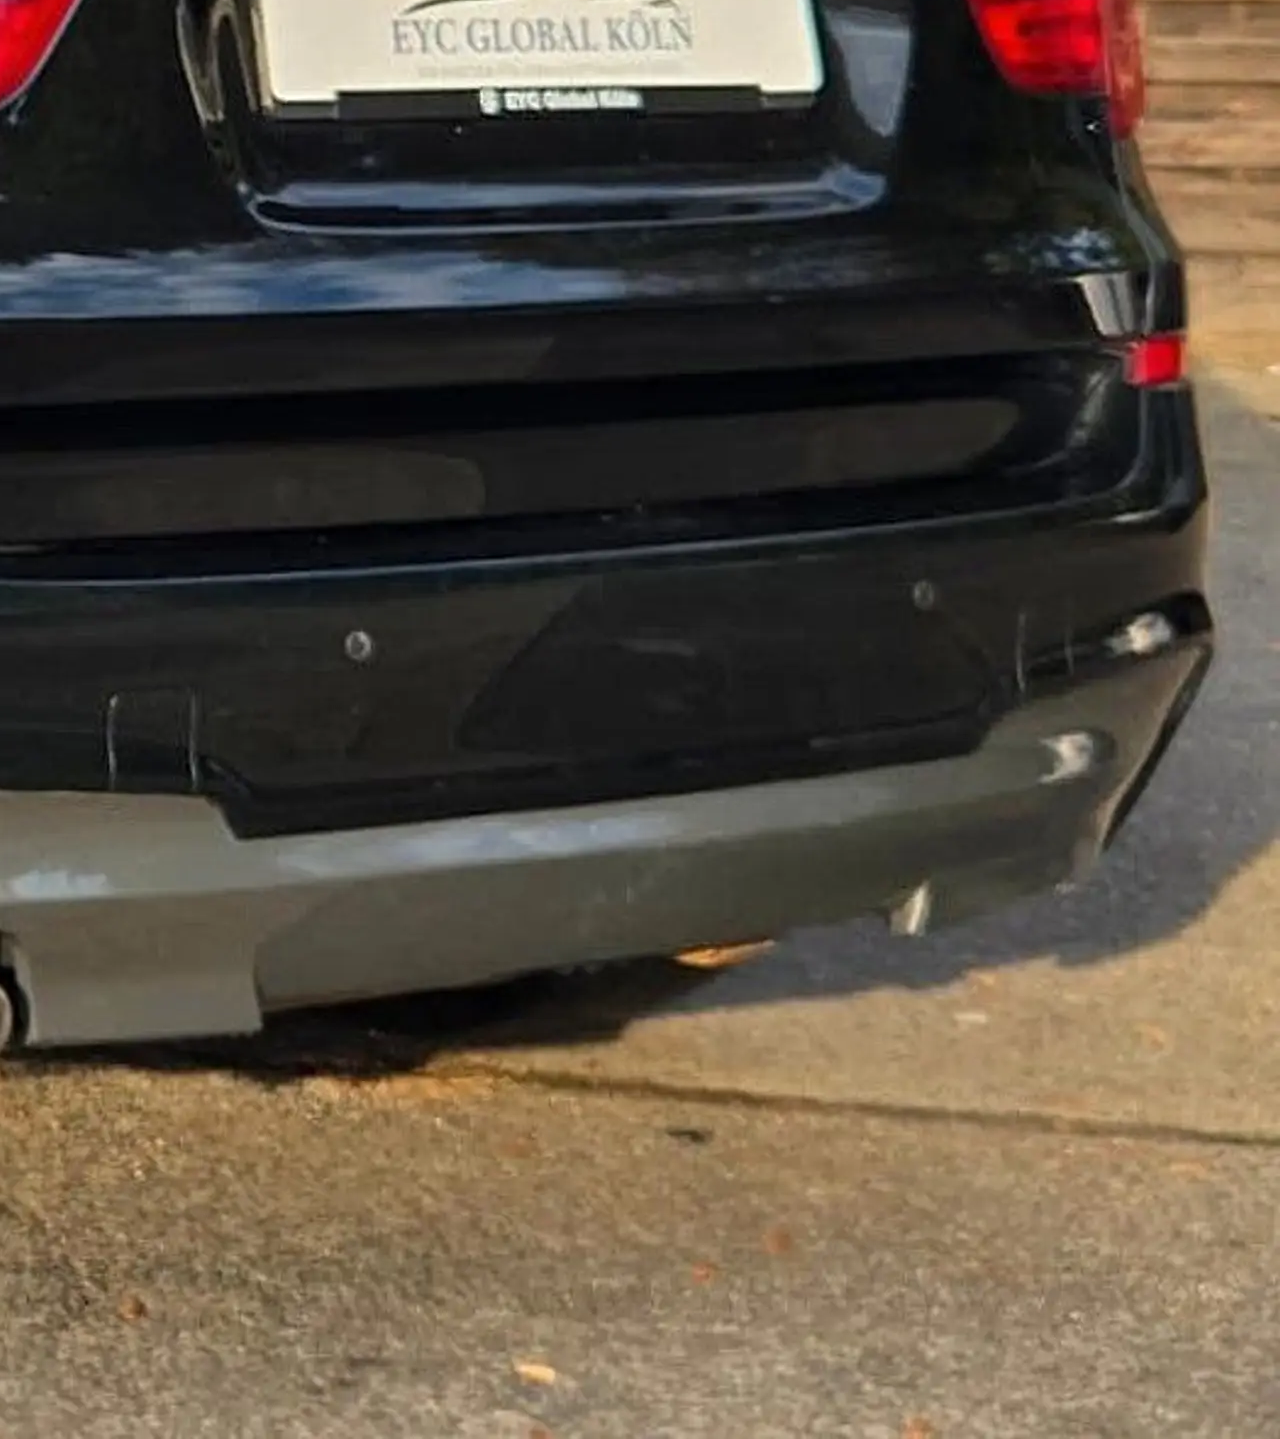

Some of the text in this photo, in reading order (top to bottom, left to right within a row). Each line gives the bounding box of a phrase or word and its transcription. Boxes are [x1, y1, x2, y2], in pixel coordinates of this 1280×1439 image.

[392, 9, 693, 54] EYC GLOBAL KÖLN
